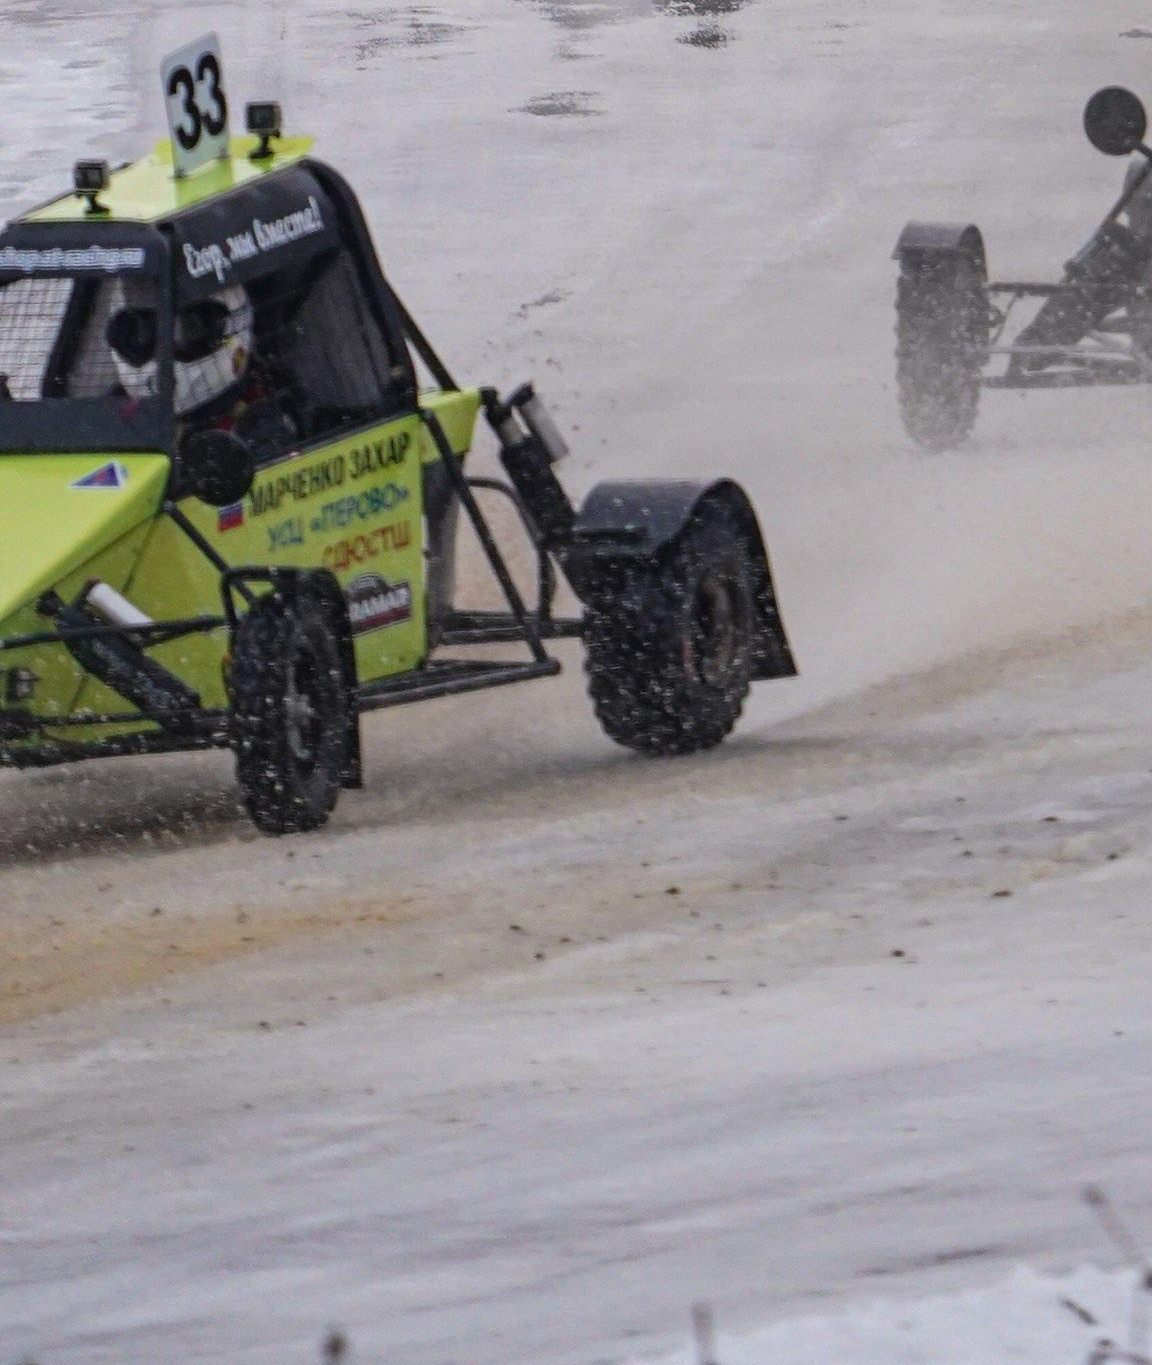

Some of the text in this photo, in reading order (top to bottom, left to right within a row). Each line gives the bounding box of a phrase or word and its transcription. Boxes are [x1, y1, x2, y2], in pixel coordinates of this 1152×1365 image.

[168, 51, 227, 150] 33
[250, 431, 410, 516] МАРЧЕНКО ЗАХАР
[310, 482, 409, 532] «ПЕРОВО»
[350, 587, 410, 622] RAMAR
